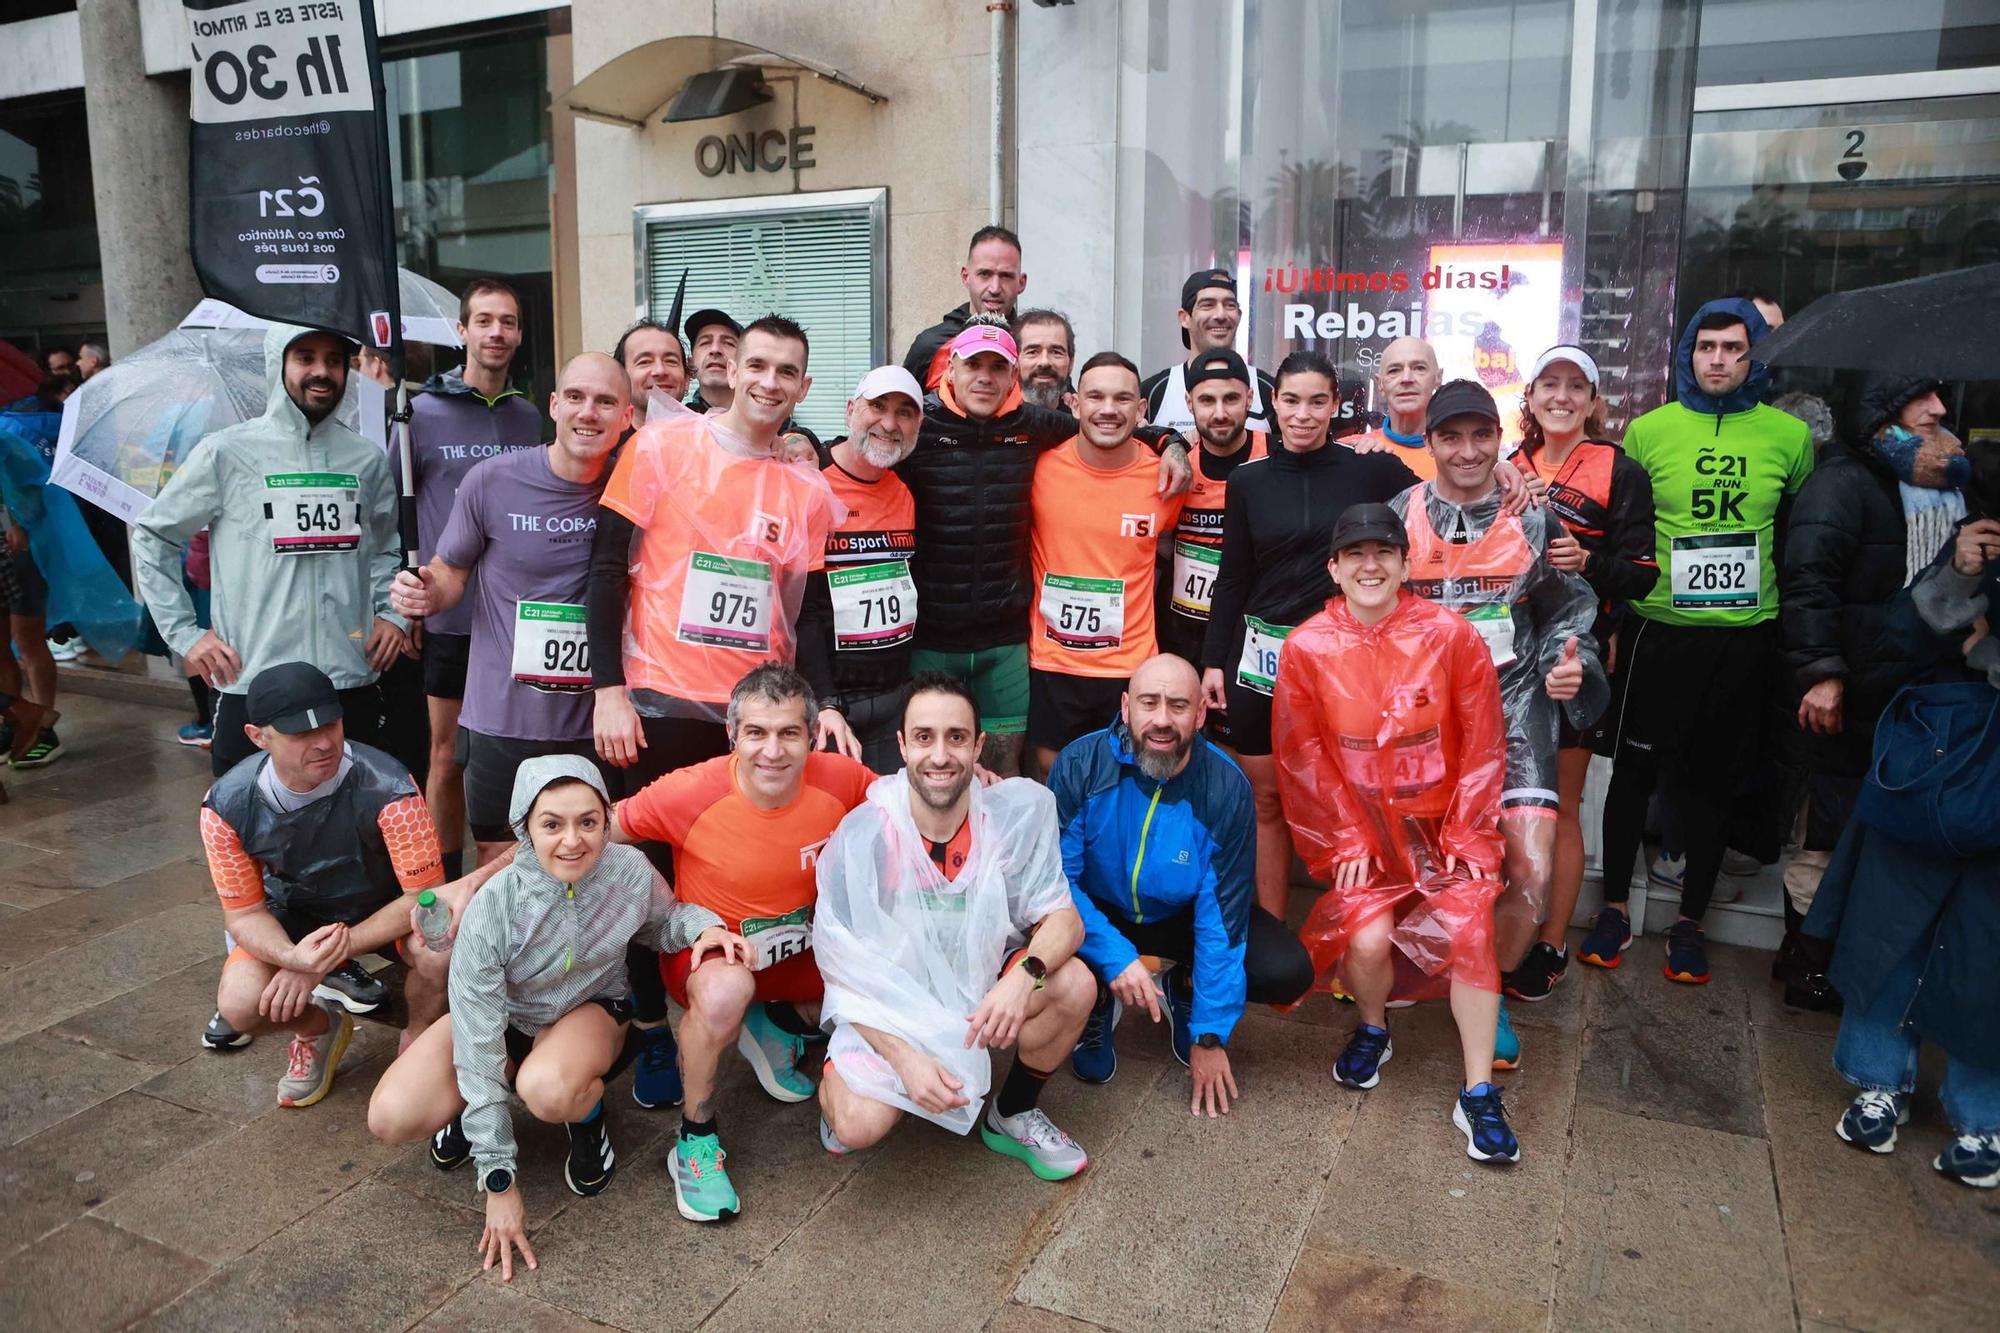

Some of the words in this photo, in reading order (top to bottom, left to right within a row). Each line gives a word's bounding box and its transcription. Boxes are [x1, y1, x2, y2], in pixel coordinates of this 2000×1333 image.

[695, 126, 816, 177] ONCE
[1843, 130, 1865, 158] 2
[1264, 261, 1409, 292] ¡Últimos
[1422, 265, 1509, 289] días!
[1284, 303, 1484, 339] Rebajas
[439, 445, 466, 459] THE
[296, 503, 341, 532] 543
[1691, 489, 1749, 522] 5K
[507, 513, 541, 532] THE
[1120, 512, 1156, 538] nsl
[1688, 562, 1746, 590] 2632
[709, 592, 758, 628] 975
[859, 595, 901, 629] 719
[1060, 604, 1101, 633] 575
[544, 639, 591, 672] 920
